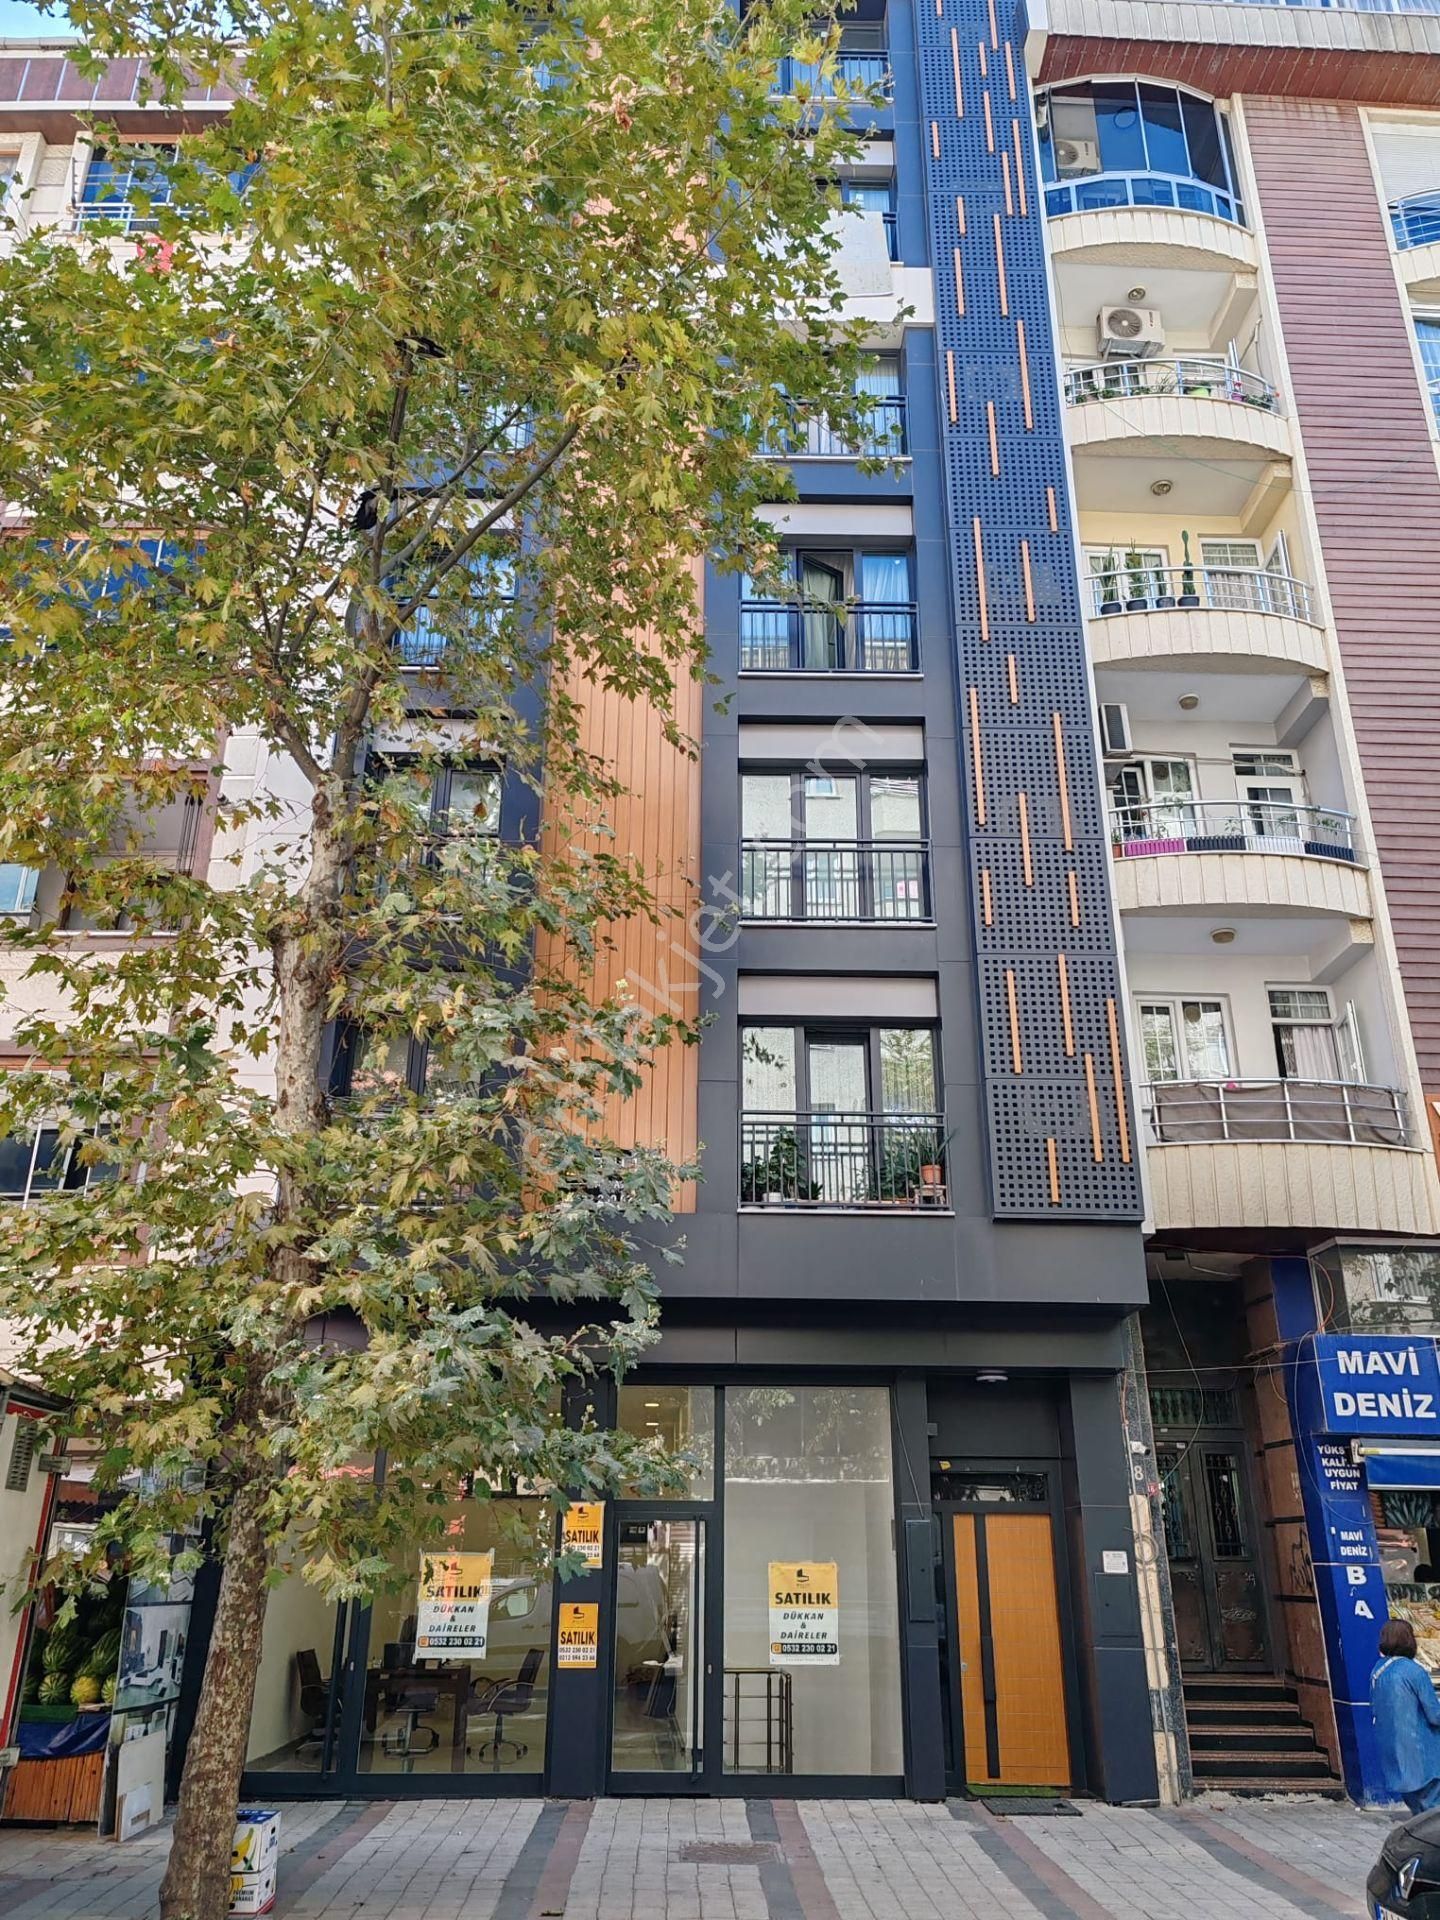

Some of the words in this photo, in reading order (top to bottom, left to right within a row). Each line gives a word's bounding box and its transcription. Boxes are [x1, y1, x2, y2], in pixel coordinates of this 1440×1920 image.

[1337, 1346, 1420, 1376] MAVİ
[1333, 1388, 1437, 1419] DENİZ
[1316, 1444, 1350, 1455] YÜKS
[1321, 1456, 1358, 1467] KALİ
[1134, 1465, 1144, 1481] 8
[1324, 1468, 1361, 1478] UYGUN
[1330, 1479, 1359, 1490] FİYAT
[565, 1529, 600, 1543] SATILIK
[1340, 1529, 1364, 1541] MAVİ
[1340, 1544, 1368, 1556] DENİZ
[427, 1586, 483, 1598] SATILIK
[775, 1592, 831, 1605] SATILIK
[433, 1603, 475, 1613] DÜKKAN
[783, 1611, 825, 1620] DÜKKAN
[429, 1623, 477, 1633] DAİRELER
[560, 1631, 596, 1645] SATILIK
[780, 1630, 828, 1639] DAİRELER
[463, 1637, 473, 1646] 02
[474, 1637, 483, 1646] 21
[782, 1645, 800, 1653] 0532
[801, 1645, 815, 1653] 230
[816, 1645, 826, 1653] 02
[827, 1645, 836, 1653] 21
